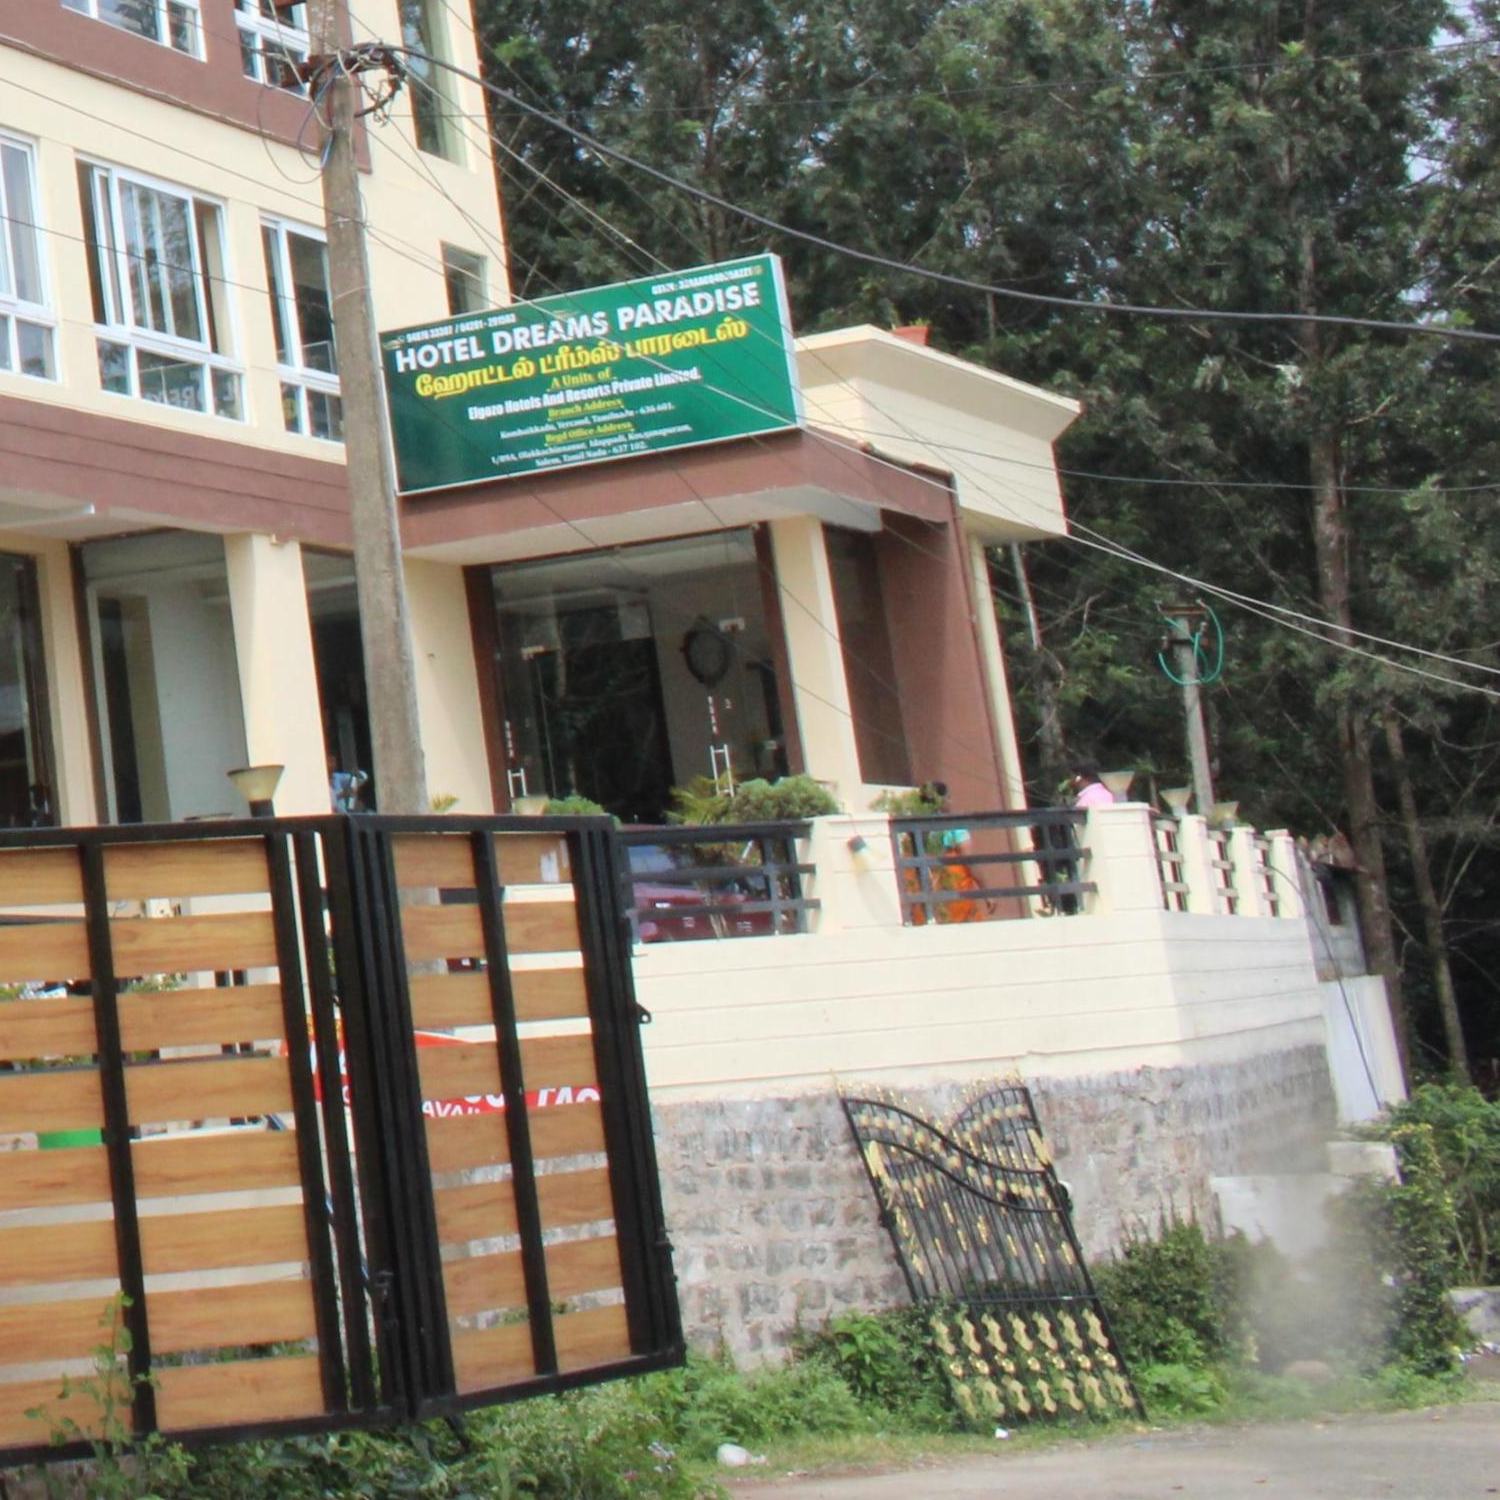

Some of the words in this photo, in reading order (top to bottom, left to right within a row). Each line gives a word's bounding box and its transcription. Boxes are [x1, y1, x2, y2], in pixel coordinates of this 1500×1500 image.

[395, 340, 486, 373] HOTEL
[492, 311, 609, 354] DREAMS
[617, 281, 761, 331] PARADISE
[415, 355, 537, 400] ஹோட்டல்
[625, 316, 748, 359] பாரடைஸ்
[597, 366, 612, 380] of
[504, 396, 542, 413] Hotels
[542, 390, 565, 407] And
[565, 384, 611, 403] Resorts
[611, 377, 654, 395] Private
